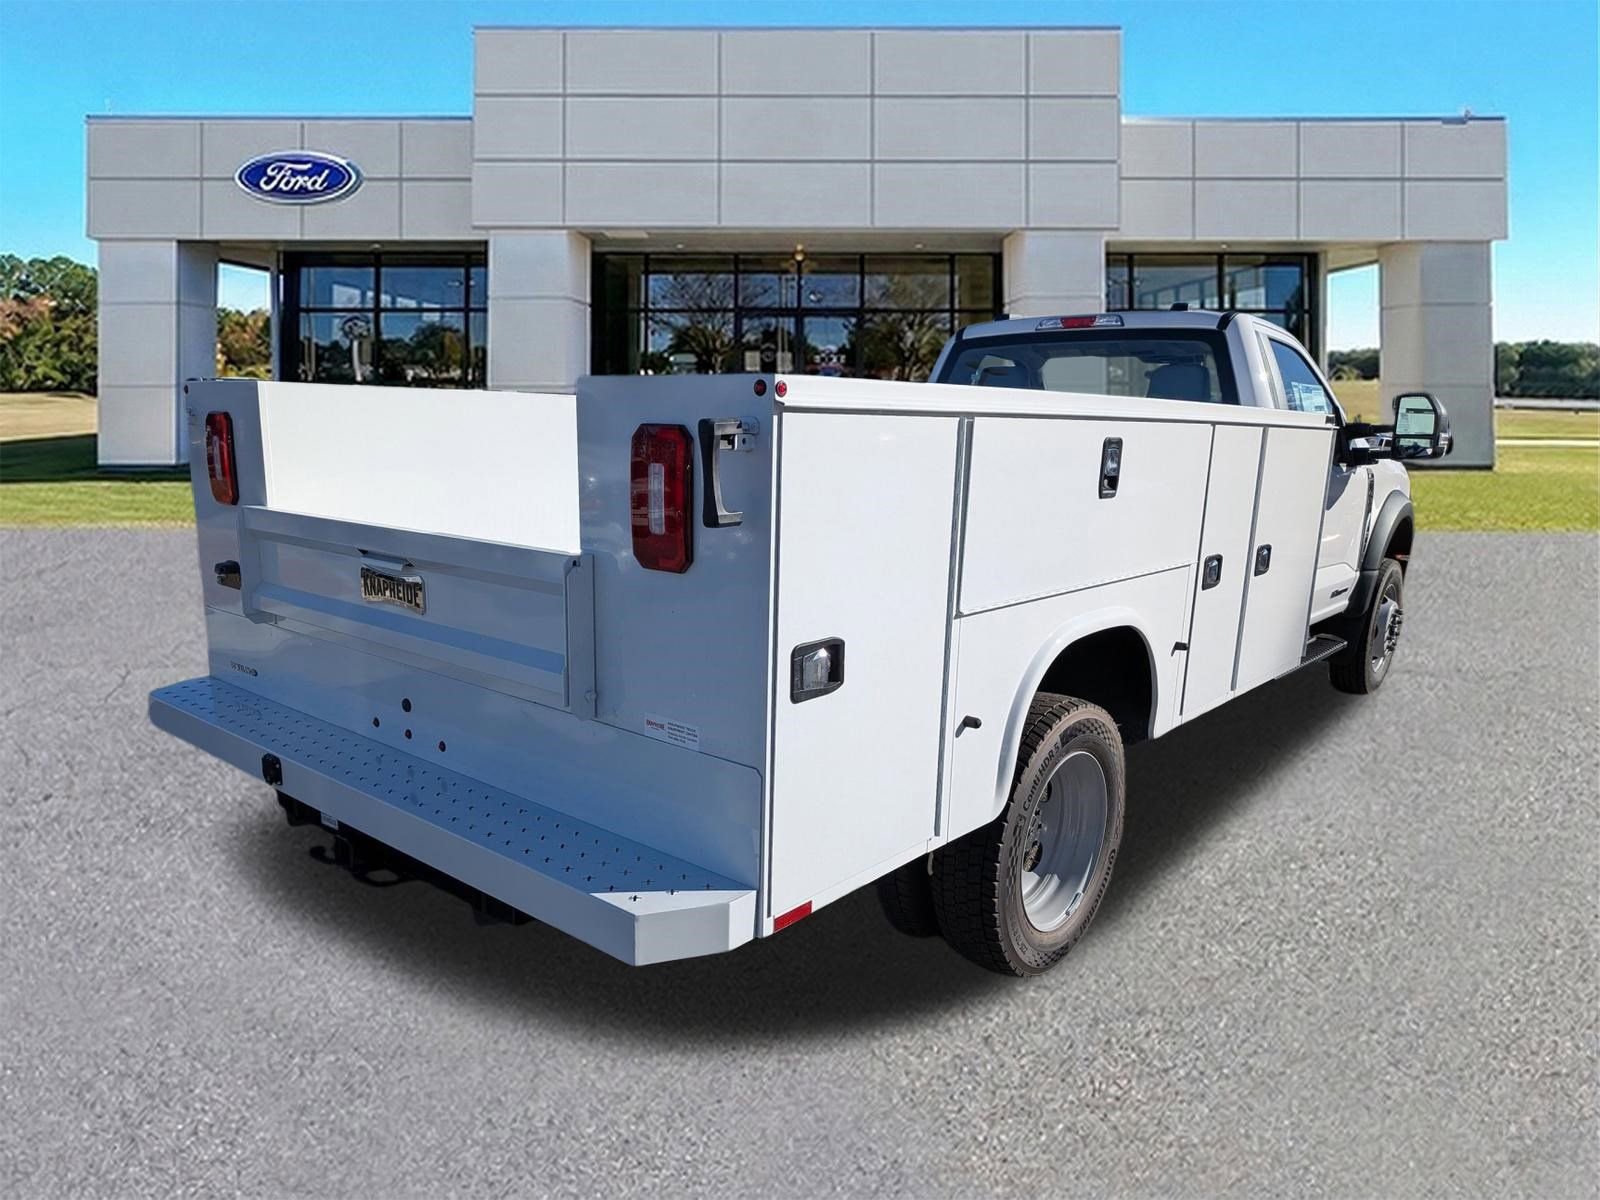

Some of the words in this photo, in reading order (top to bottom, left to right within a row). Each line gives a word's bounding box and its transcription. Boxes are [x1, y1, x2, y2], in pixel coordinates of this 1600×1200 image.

[260, 162, 330, 191] Ford
[363, 572, 423, 609] KNAPHEIDE
[1022, 774, 1041, 812] Conti
[1038, 749, 1056, 778] HDR
